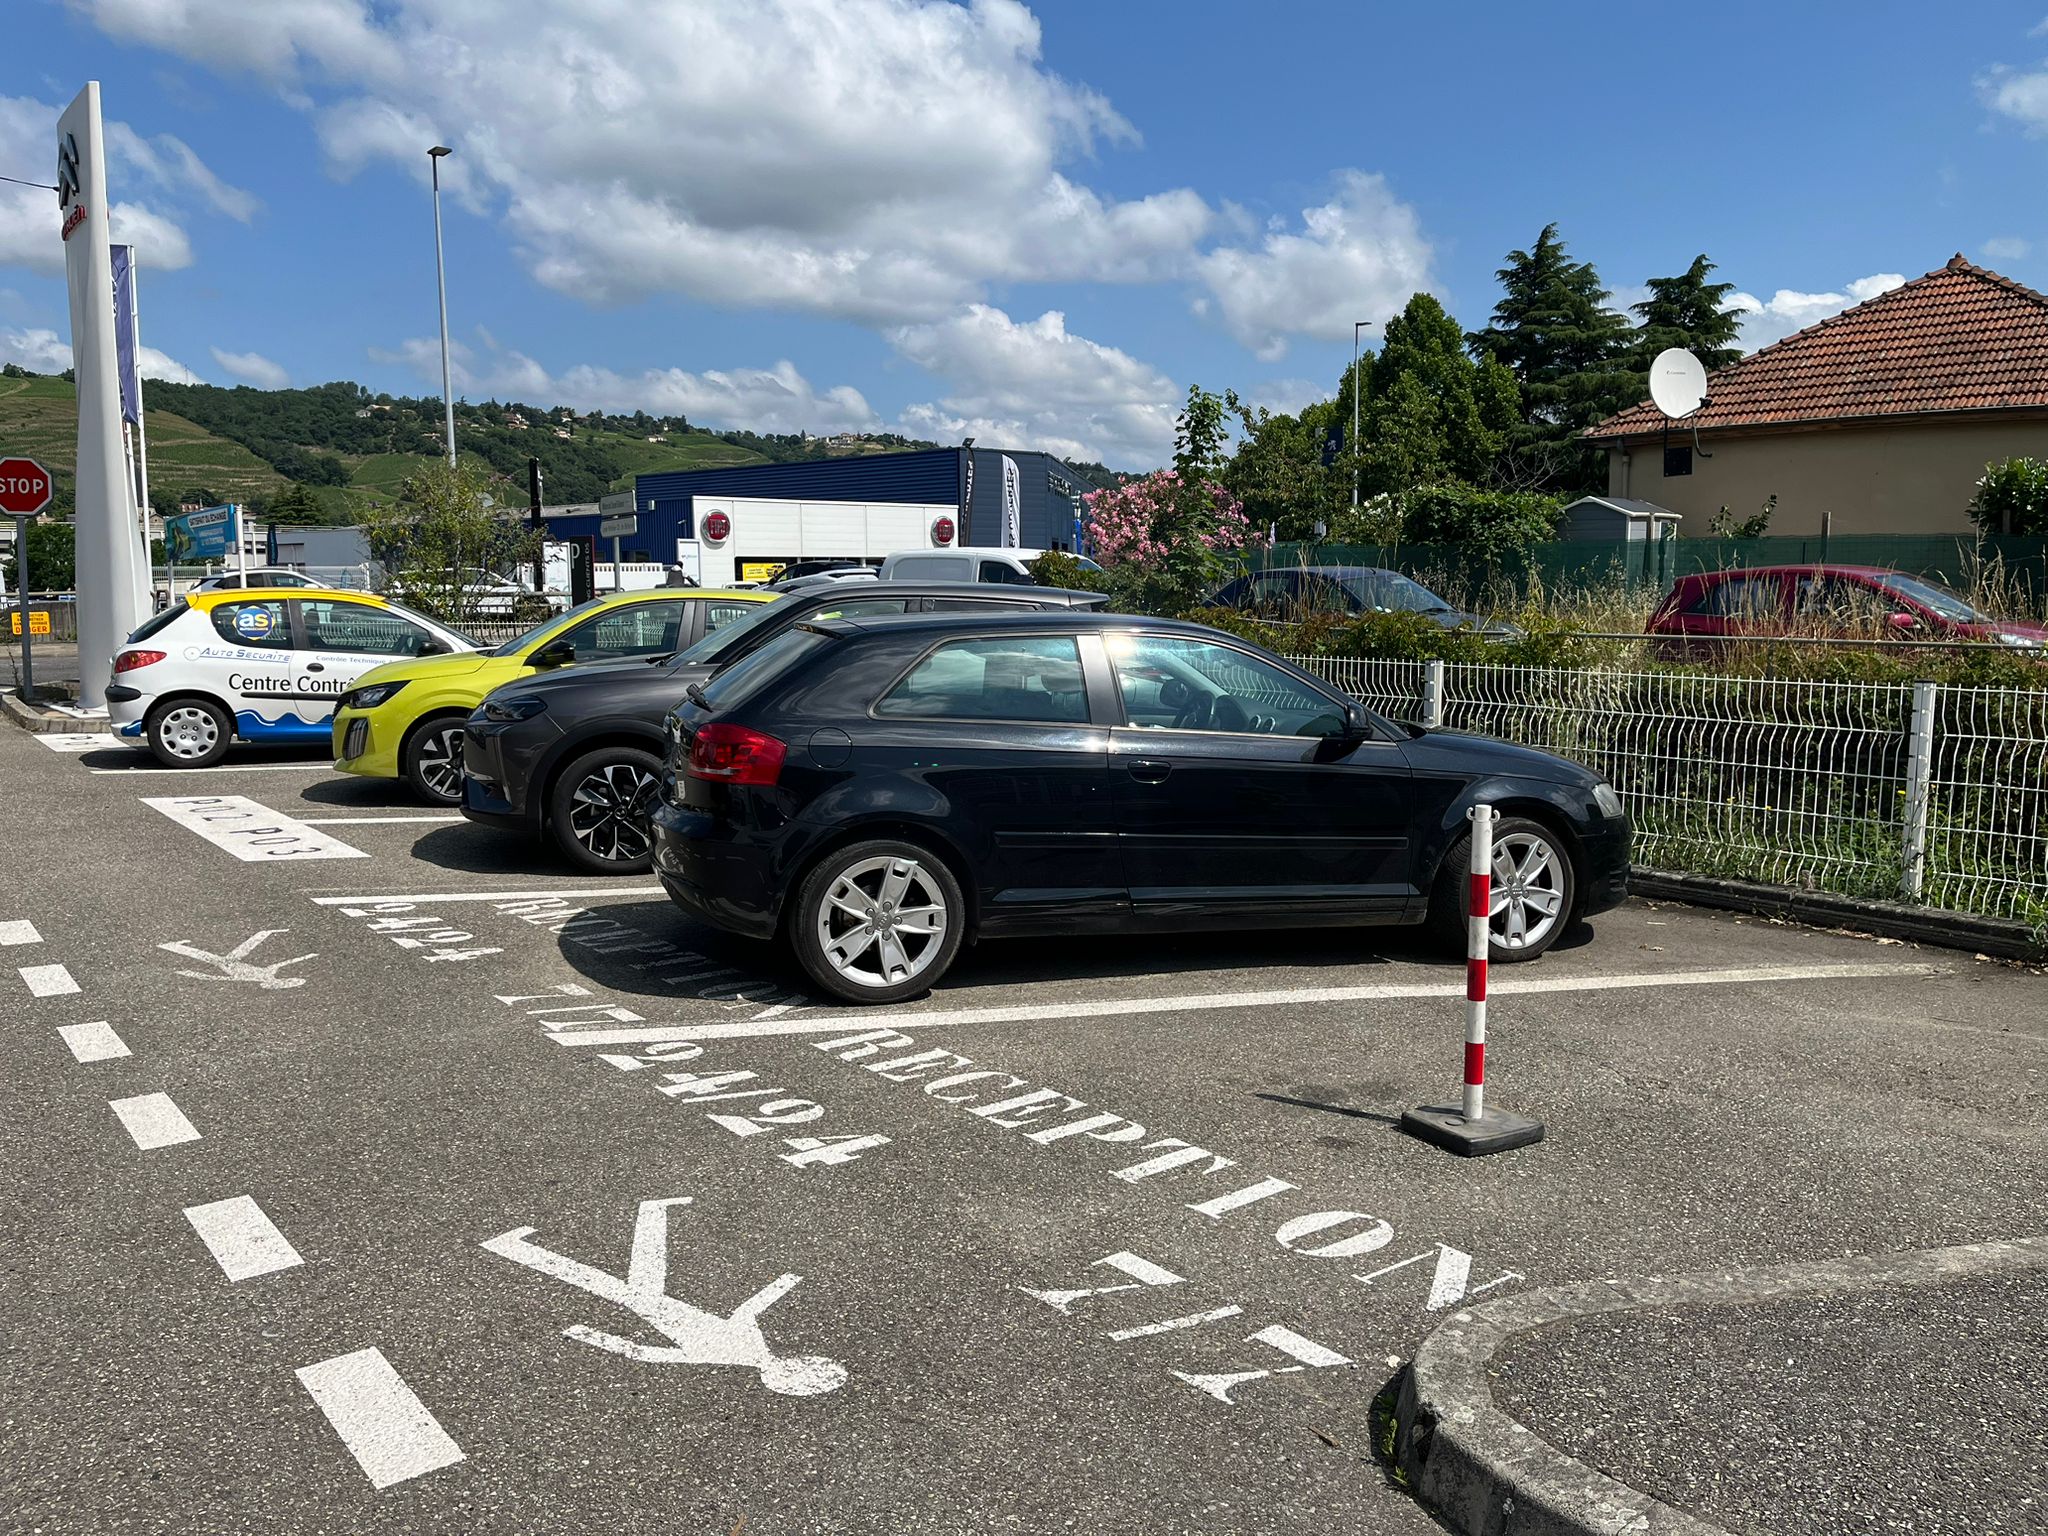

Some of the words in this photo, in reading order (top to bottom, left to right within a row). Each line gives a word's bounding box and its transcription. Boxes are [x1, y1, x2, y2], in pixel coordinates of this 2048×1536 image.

[0, 478, 44, 494] STOP
[16, 625, 47, 633] DGER
[228, 673, 291, 691] Centre
[597, 1041, 893, 1169] 24/24
[809, 1027, 1526, 1312] RECEPTION
